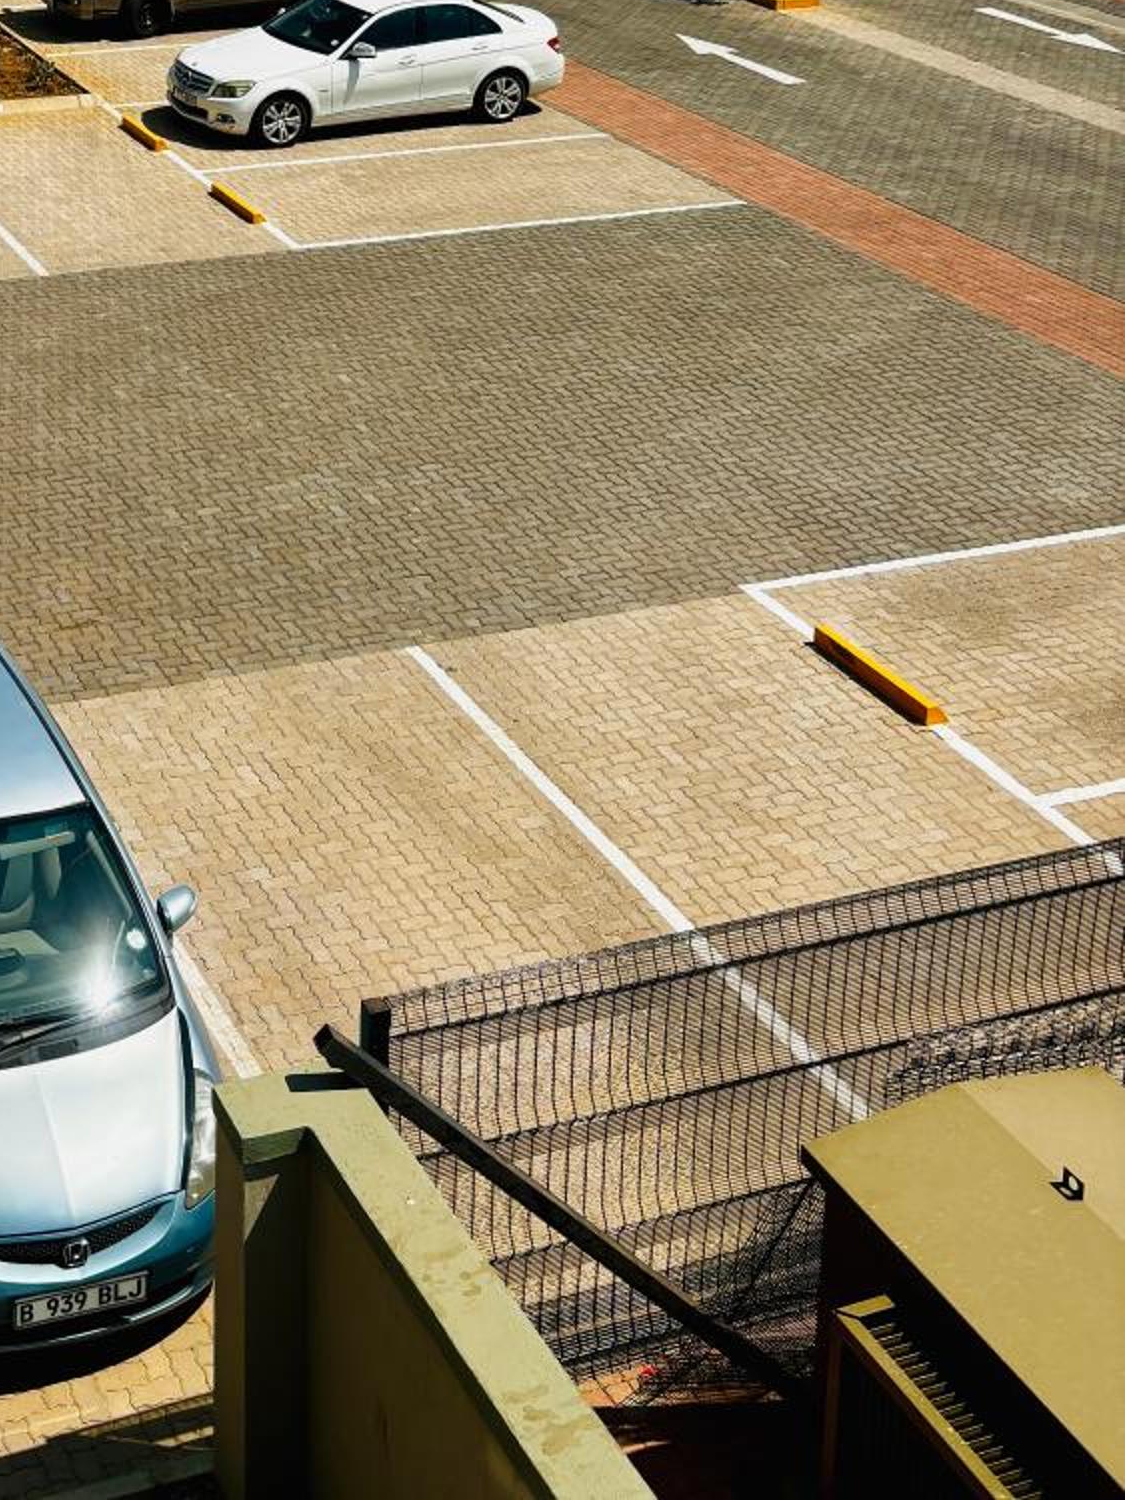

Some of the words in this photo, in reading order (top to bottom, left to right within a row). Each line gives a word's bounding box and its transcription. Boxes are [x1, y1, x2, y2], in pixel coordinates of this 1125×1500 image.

[20, 1303, 34, 1323] B
[46, 1291, 88, 1317] 939
[98, 1279, 143, 1305] BLJ
